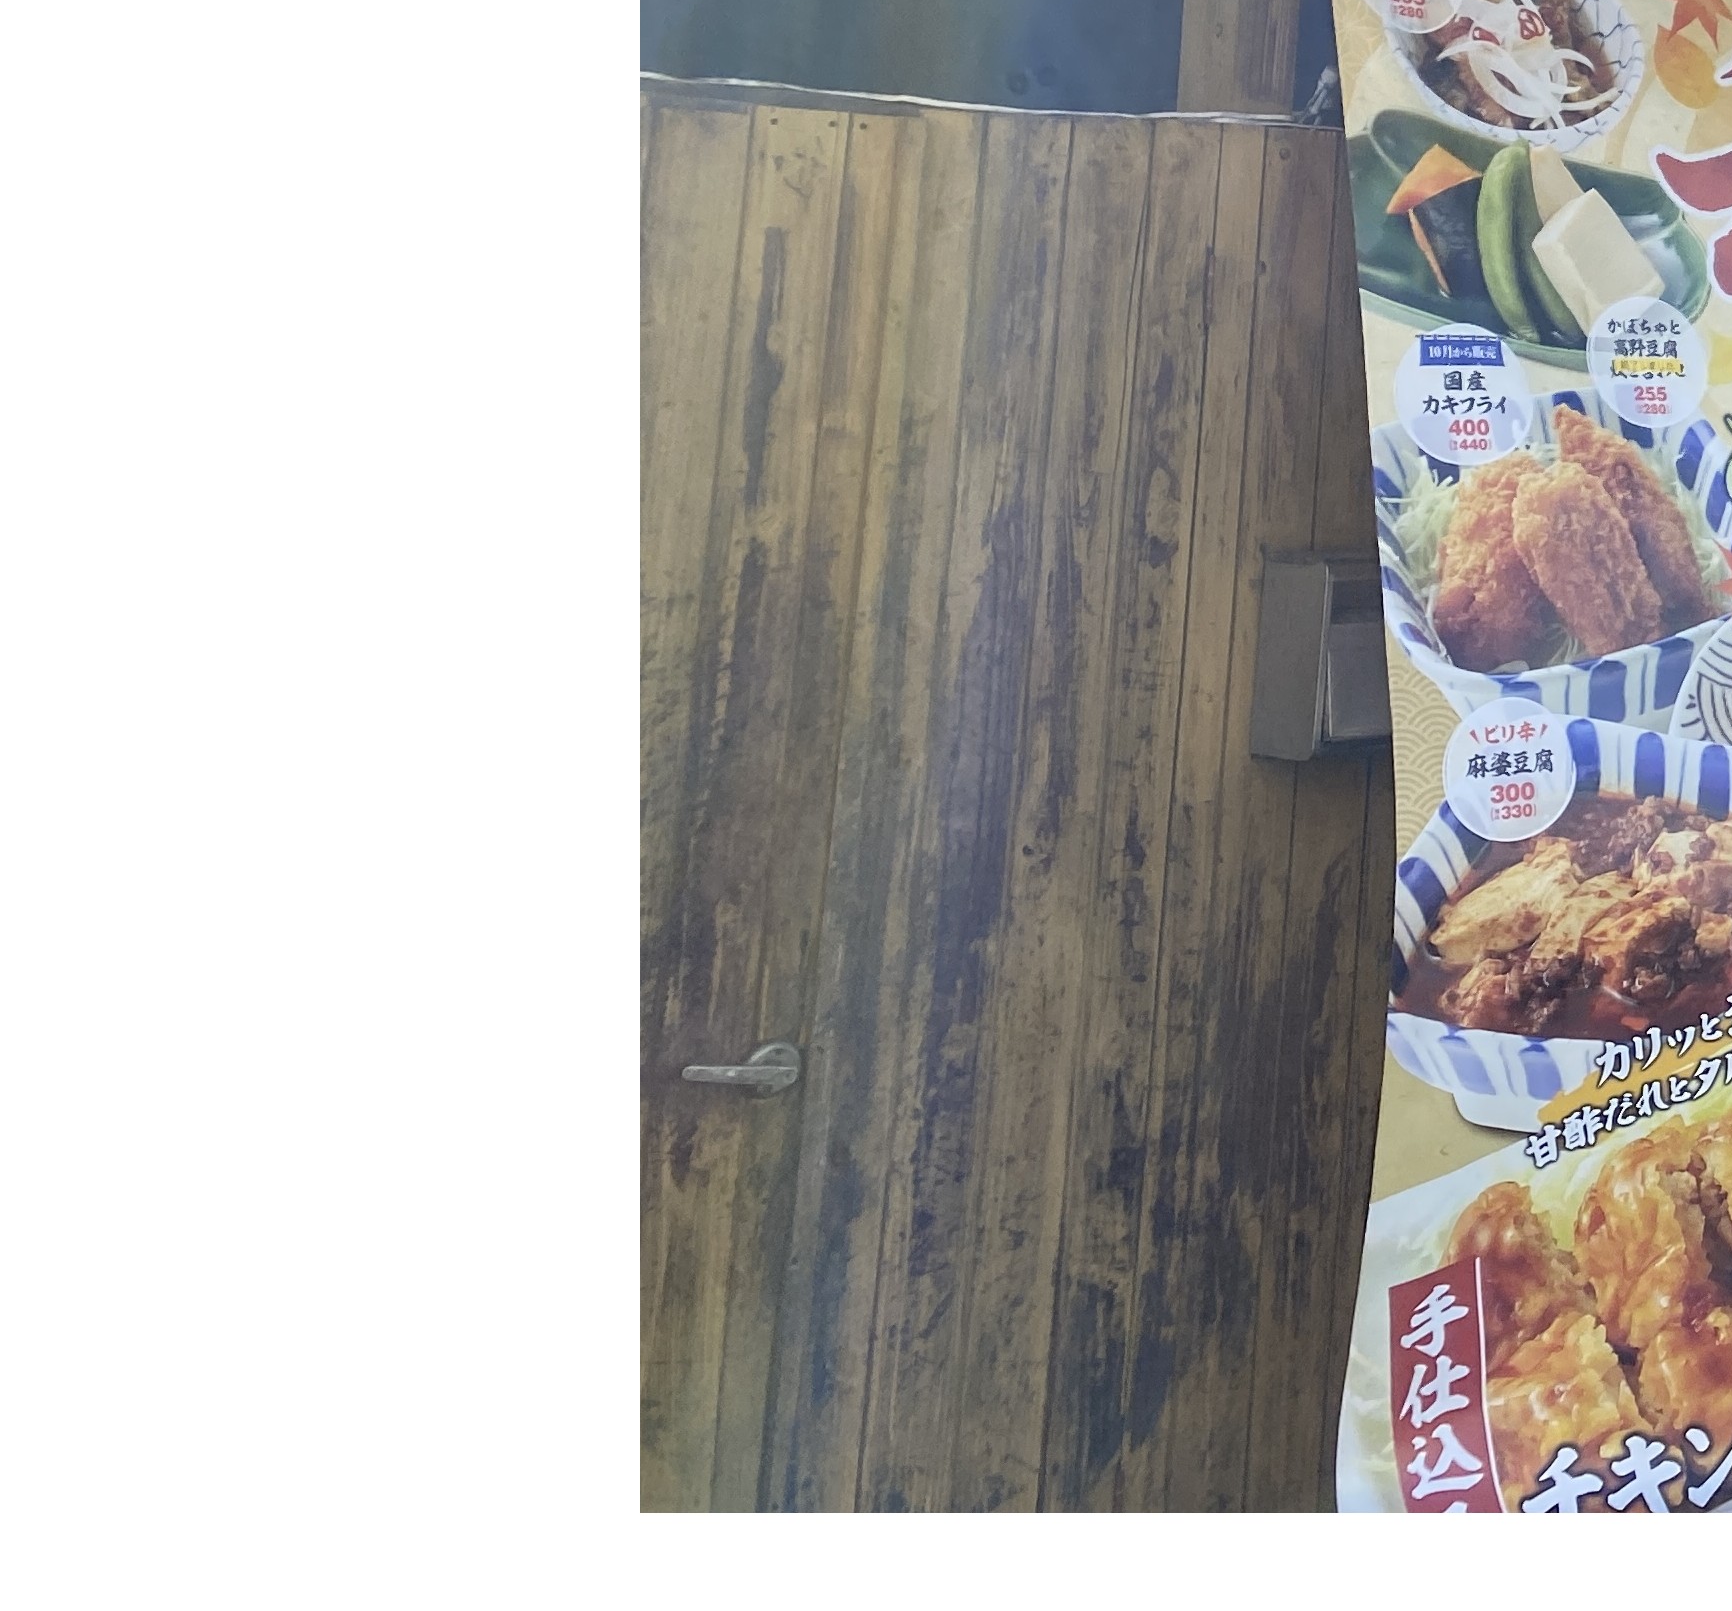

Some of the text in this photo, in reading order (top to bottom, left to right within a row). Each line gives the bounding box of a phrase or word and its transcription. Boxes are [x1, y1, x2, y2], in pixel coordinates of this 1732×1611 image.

[1443, 370, 1487, 391] 国産
[1634, 385, 1667, 402] 255
[1422, 394, 1507, 415] カキフライ
[1448, 418, 1490, 436] 400
[1466, 748, 1554, 779] 麻婆豆腐
[1489, 781, 1535, 804] 300
